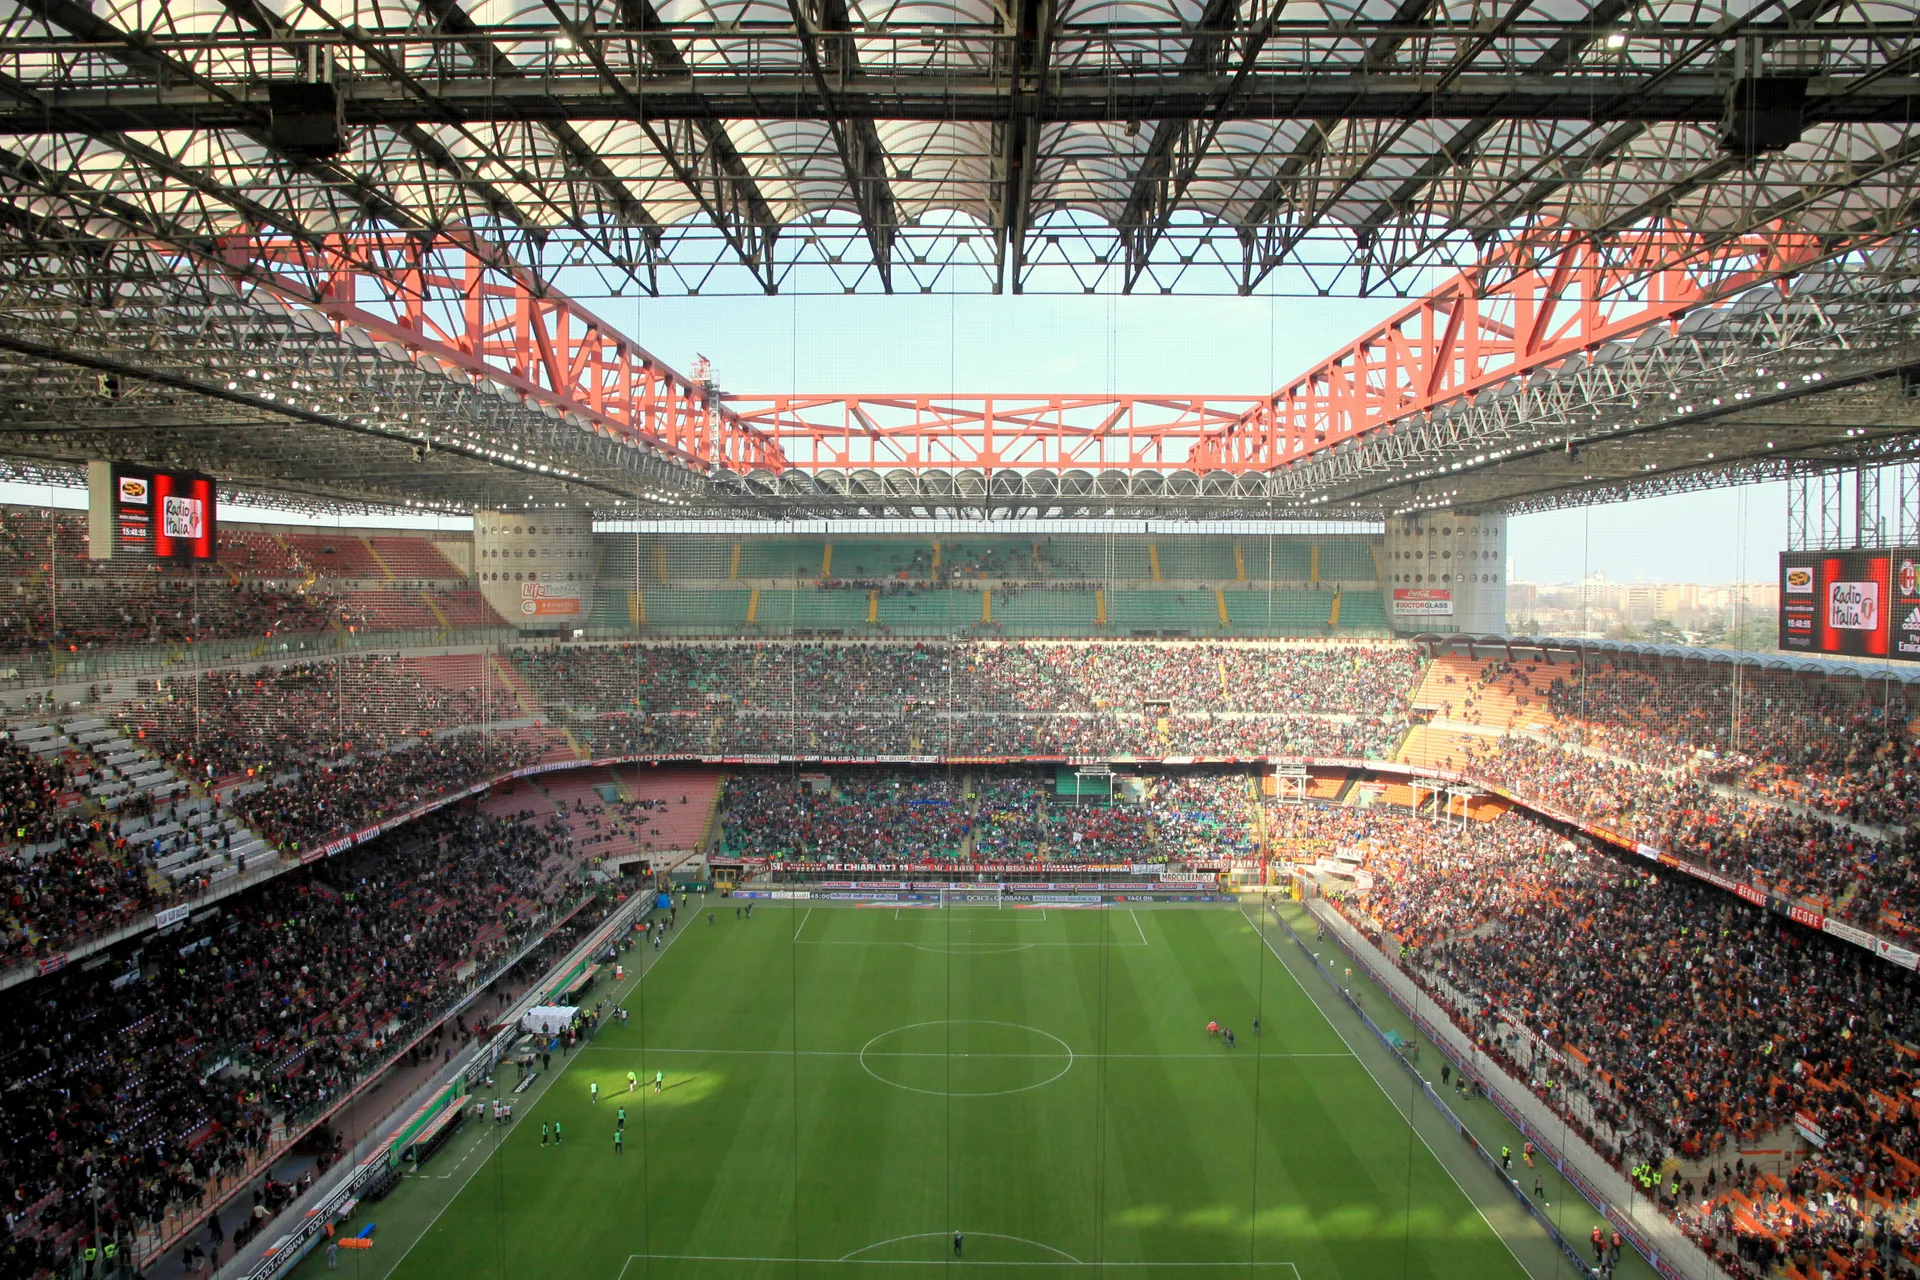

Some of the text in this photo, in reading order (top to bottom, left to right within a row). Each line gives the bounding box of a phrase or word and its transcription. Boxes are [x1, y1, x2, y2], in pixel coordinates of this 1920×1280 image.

[166, 500, 189, 516] Radio
[166, 517, 189, 534] Italia
[1833, 584, 1861, 604] Radio
[1833, 605, 1861, 625] Italia
[621, 754, 693, 763] LANDRIANO
[1268, 756, 1362, 767] NAVIGLIO ROSSONERO
[844, 863, 876, 871] CHIARI
[979, 864, 1004, 872] BASSANO
[1005, 864, 1038, 872] BRESCIANO
[1230, 860, 1259, 869] PAINA
[1162, 873, 1212, 882] MARCO NICO
[1738, 885, 1768, 907] BERNATE
[1786, 905, 1819, 927] ARCORE
